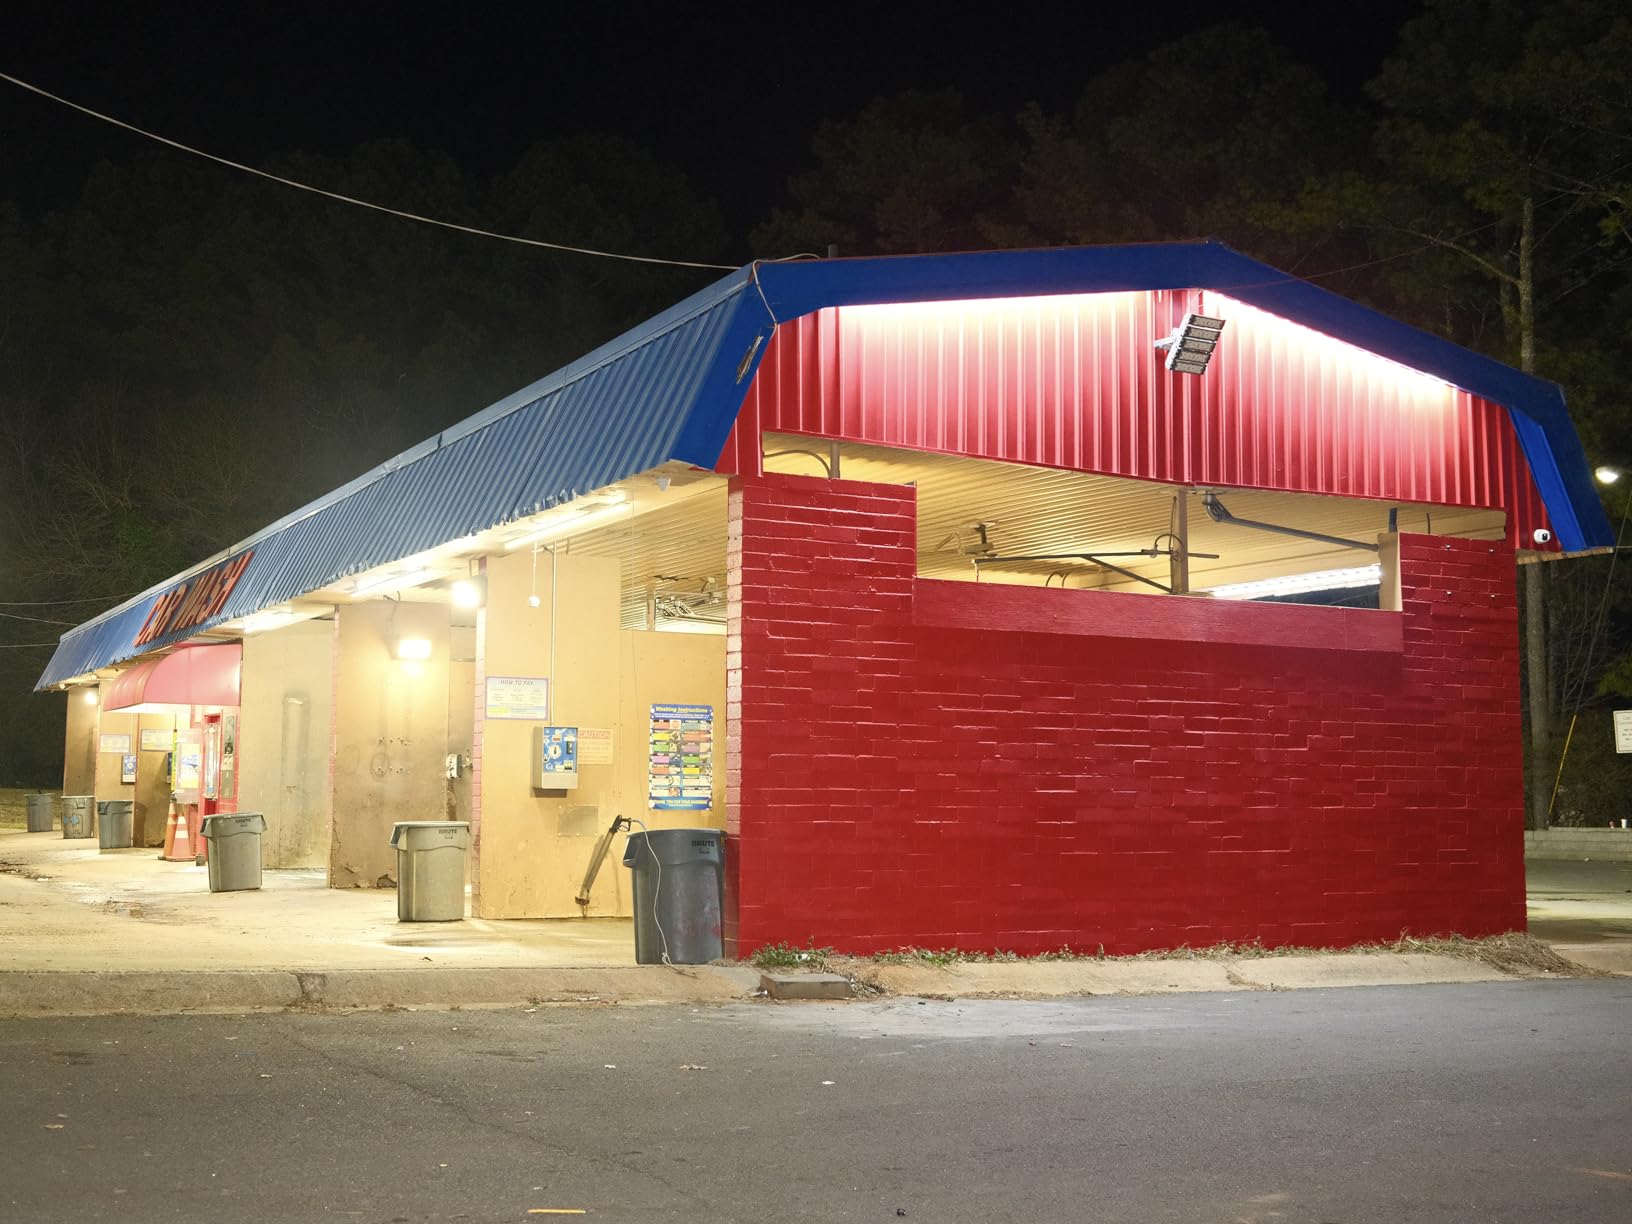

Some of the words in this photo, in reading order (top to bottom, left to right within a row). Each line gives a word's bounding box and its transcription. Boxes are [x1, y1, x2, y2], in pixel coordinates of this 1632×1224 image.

[133, 582, 189, 648] CAR
[168, 549, 255, 634] WASH
[691, 840, 715, 848] BRUTE
